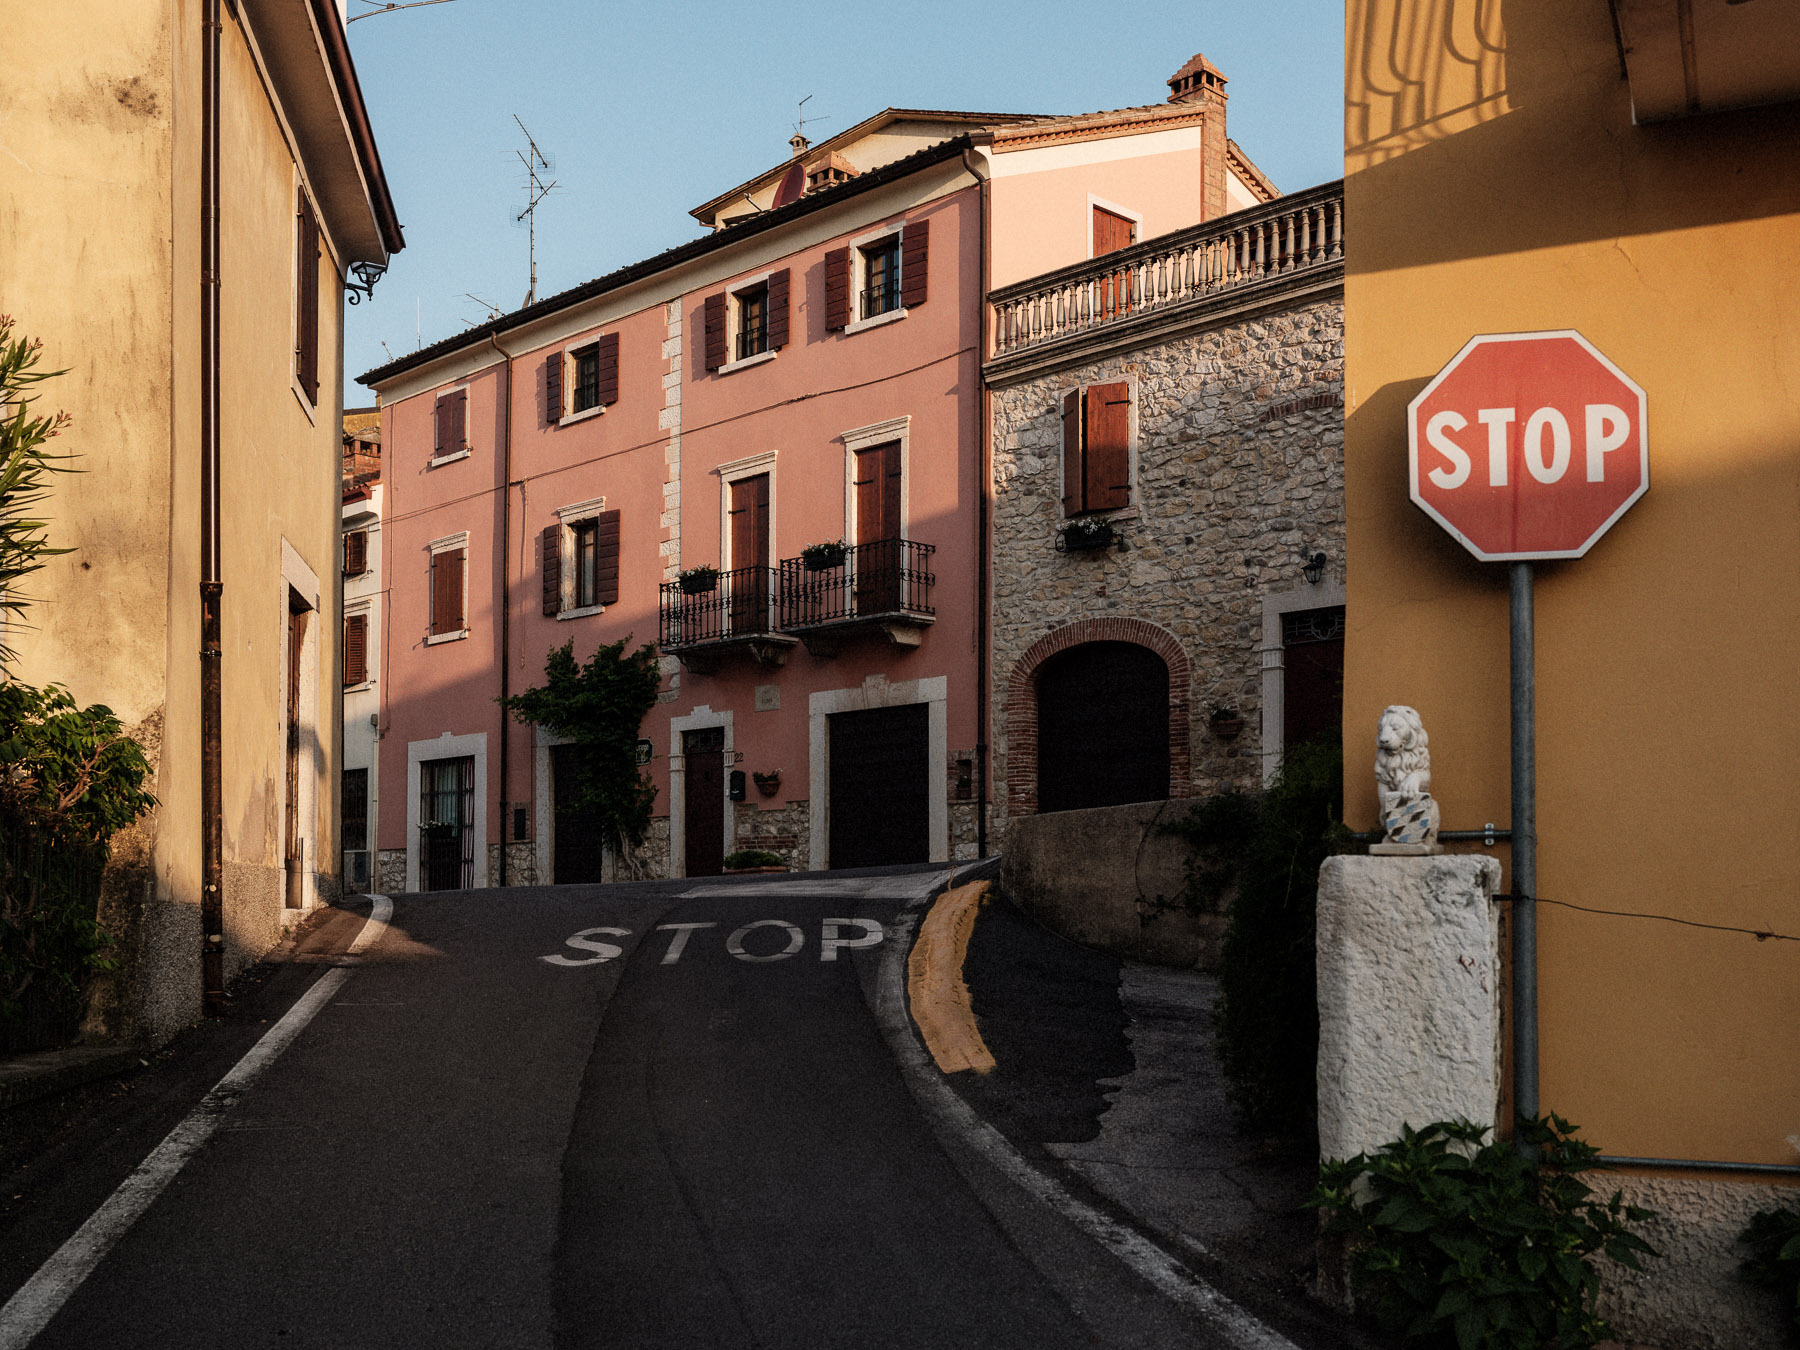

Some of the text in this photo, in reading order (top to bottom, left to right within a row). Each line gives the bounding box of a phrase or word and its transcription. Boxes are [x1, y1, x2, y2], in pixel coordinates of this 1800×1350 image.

[1426, 404, 1630, 489] STOP
[734, 752, 744, 763] 22
[537, 918, 884, 967] STOP
